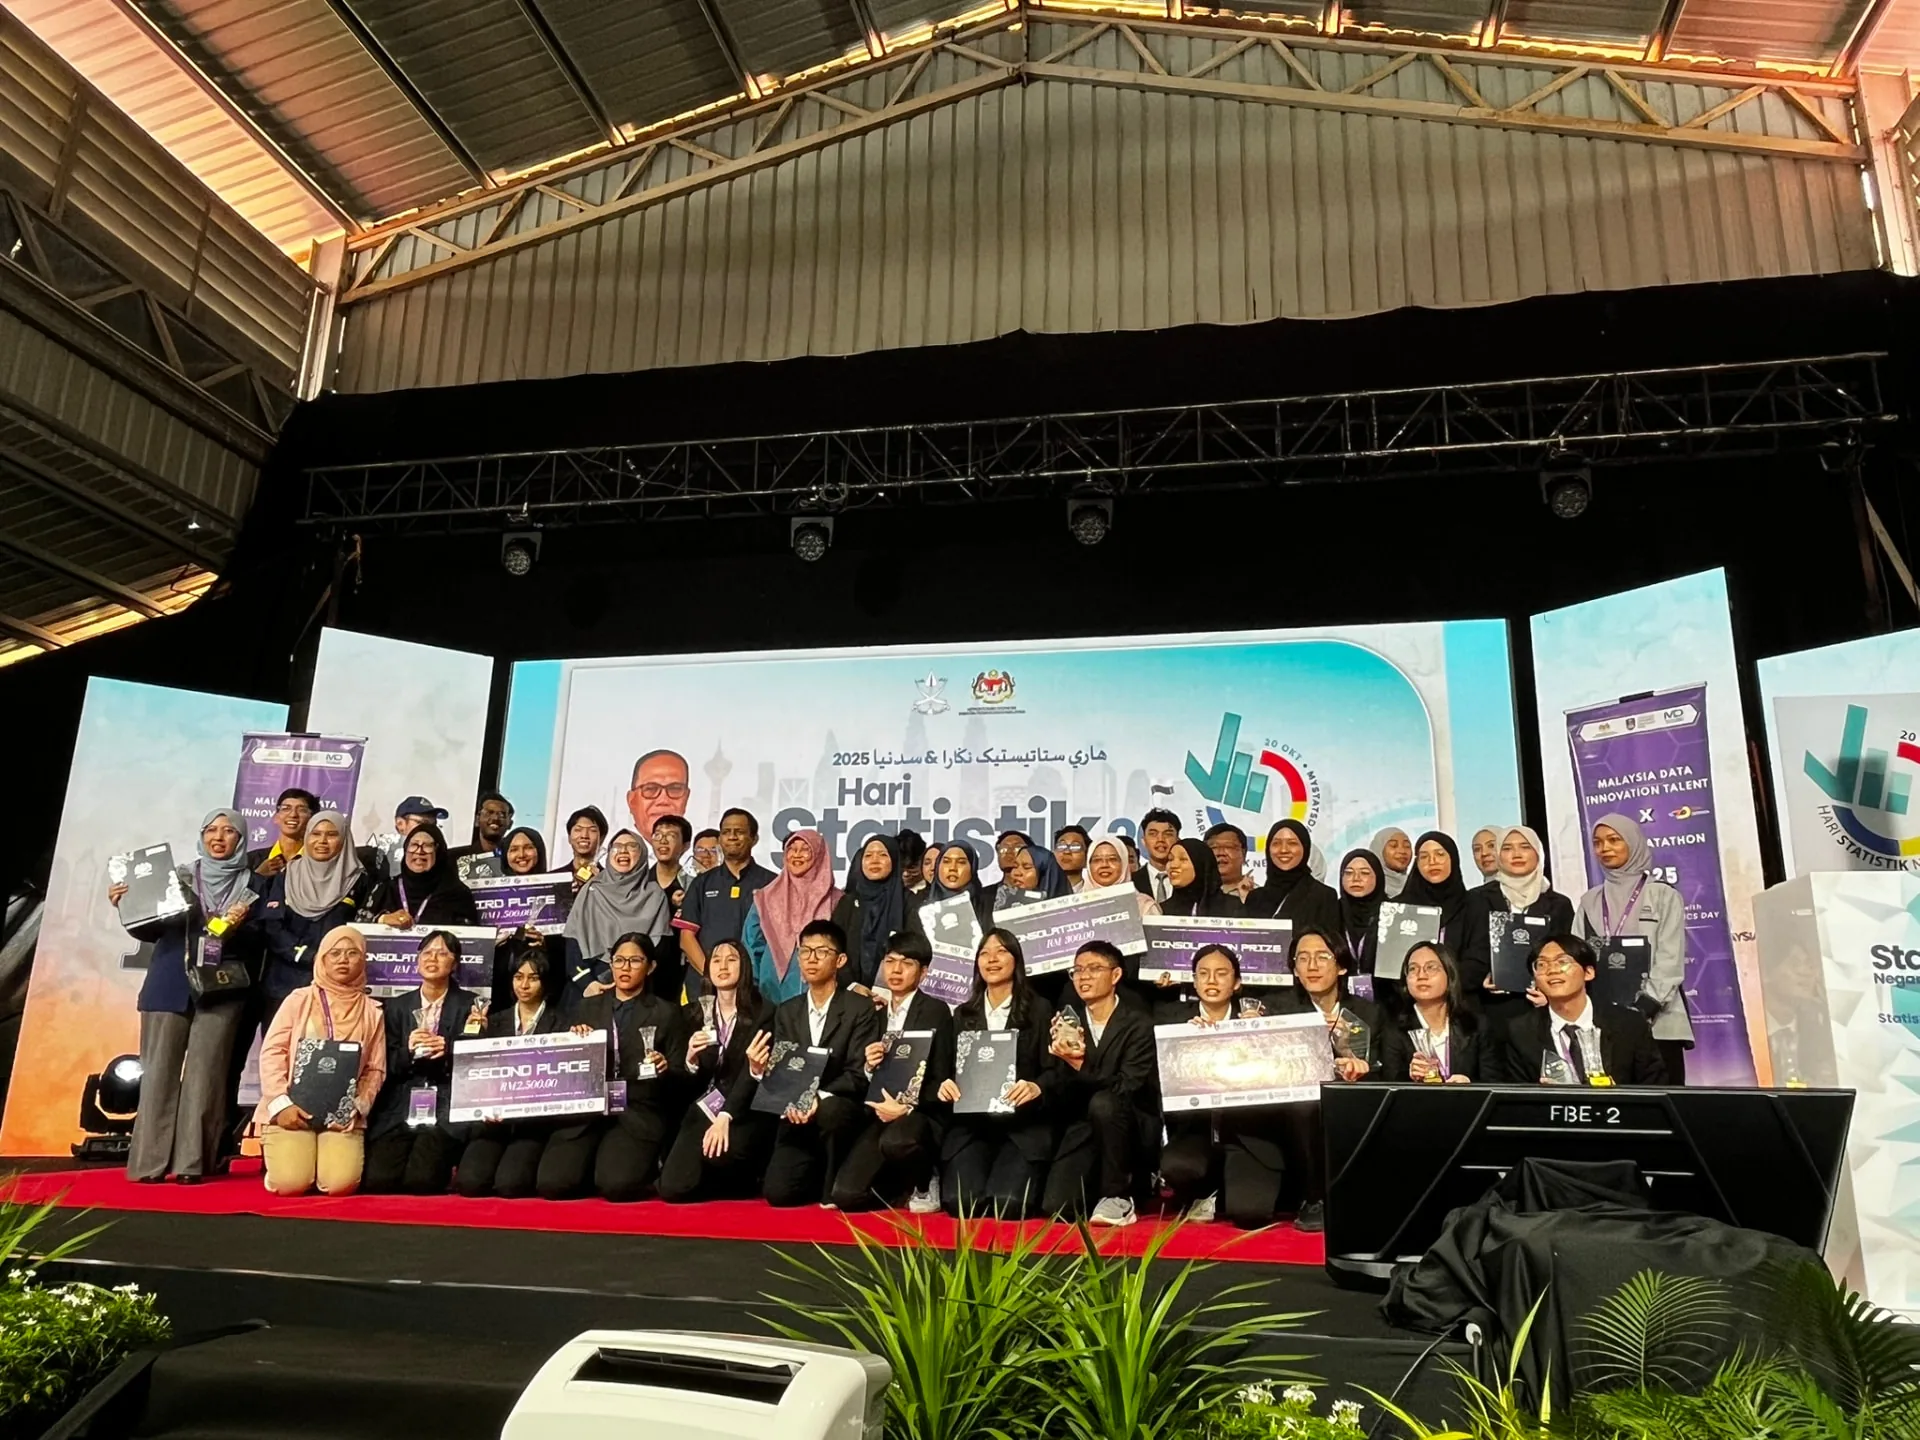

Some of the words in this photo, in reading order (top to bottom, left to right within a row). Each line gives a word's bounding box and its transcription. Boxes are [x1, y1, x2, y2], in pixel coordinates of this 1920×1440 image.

[1900, 730, 1917, 742] 20
[1264, 738, 1278, 748] 20
[1281, 743, 1302, 760] OKT
[833, 752, 870, 766] 2025
[1597, 770, 1657, 789] MALAYSIA
[1660, 765, 1693, 779] DATA
[838, 773, 911, 806] Hari
[1586, 784, 1660, 805] INNOVATION
[1663, 778, 1709, 793] TALENT
[241, 808, 276, 818] INNOV
[1646, 833, 1706, 848] ATATHON
[1817, 804, 1841, 836] HARI
[1837, 835, 1908, 871] STATISTIK
[474, 898, 504, 910] IRD
[1701, 911, 1719, 919] DAY
[1016, 919, 1089, 943] ONSOLATION
[1091, 911, 1130, 927] PRIZE
[1046, 936, 1061, 949] RM
[1241, 943, 1282, 954] PRIZE
[366, 952, 418, 963] ONSOLAT
[460, 954, 484, 964] IZE
[1870, 944, 1920, 970] Sta
[1878, 1013, 1919, 1024] Statis
[467, 1064, 532, 1080] SECOND
[536, 1060, 590, 1076] PLACE
